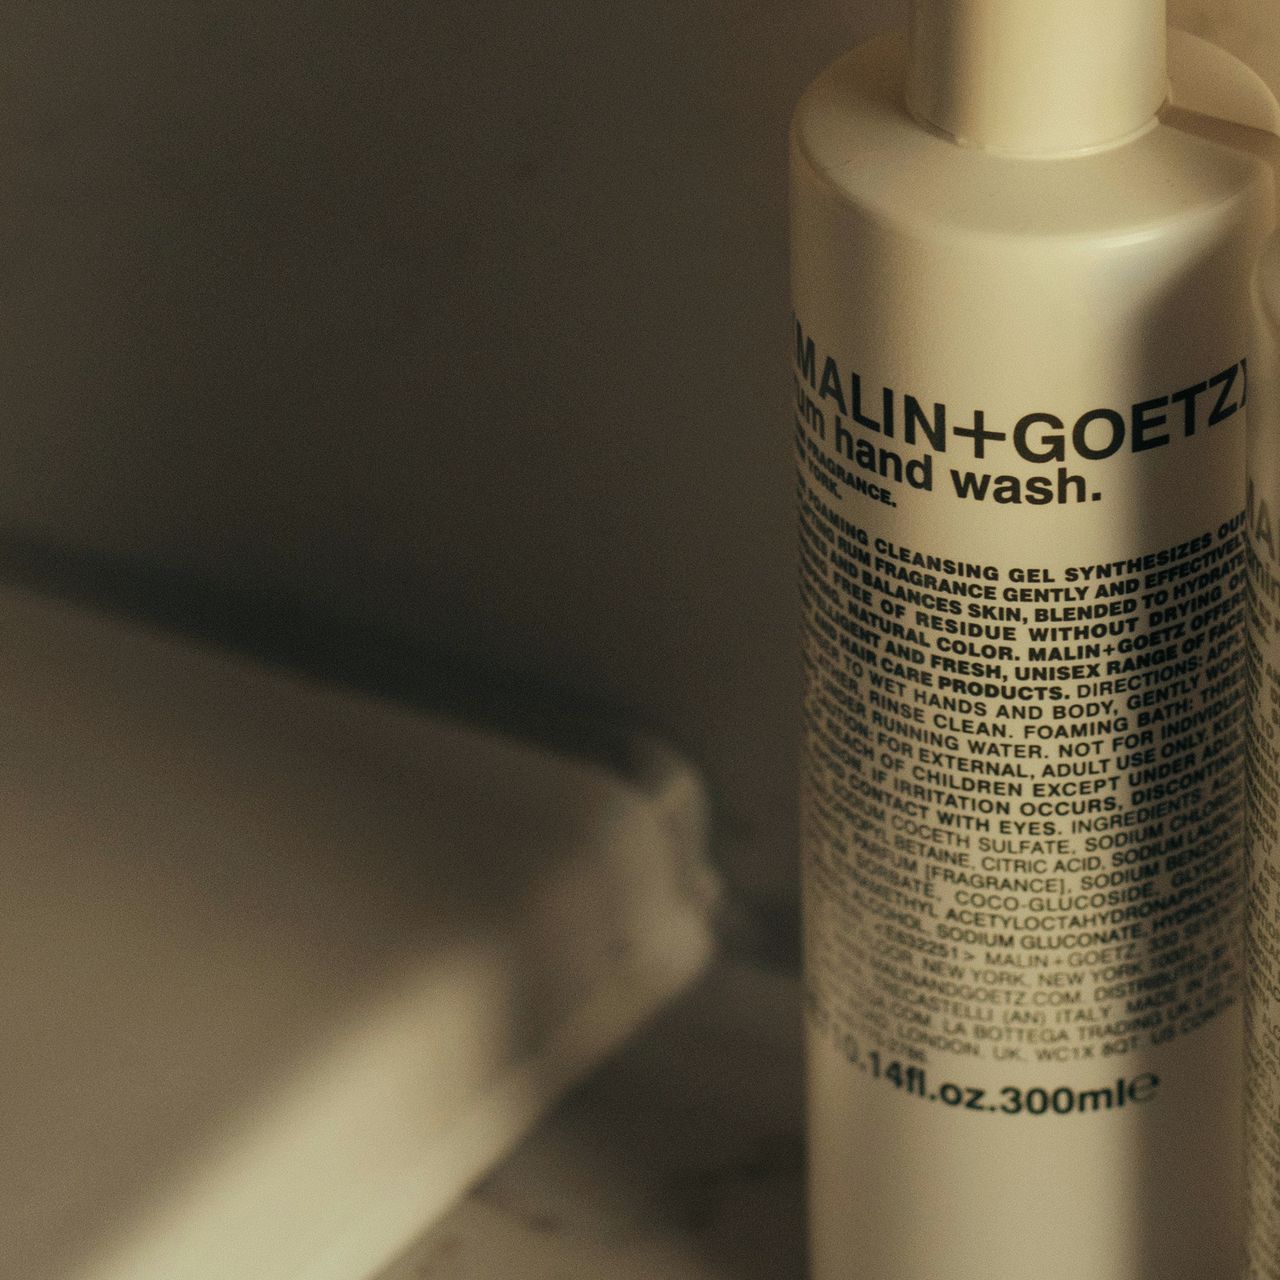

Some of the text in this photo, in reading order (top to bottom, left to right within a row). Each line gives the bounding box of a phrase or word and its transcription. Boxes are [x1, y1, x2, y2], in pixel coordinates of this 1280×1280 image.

[835, 416, 933, 492] hand
[950, 467, 1102, 506] wash.
[874, 537, 1000, 581] CLEANSING
[1008, 568, 1056, 583] GEL
[1064, 530, 1212, 582] SYNTHESIZES
[874, 557, 1140, 603] FRAGRANCE GENTLY AND
[834, 570, 1222, 642] FREE OF RESIDUE WITHOUT DRYING
[862, 569, 1168, 626] BALANCES SKIN, BLENDED TO
[848, 599, 1186, 661] NATURAL COLOR. MALIN+GOETZ
[882, 652, 1204, 700] CARE PRODUCTS. DIRECTIONS:
[886, 632, 1204, 684] AND FRESH, UNISEX RANGE OF
[868, 670, 1200, 720] WET HANDS AND BODY, GENTLY
[870, 689, 1194, 739] RINSE CLEAN. FOAMING BATH:
[872, 710, 1154, 759] RUNNING WATER. NOT FOR
[876, 731, 1156, 782] FOR EXTERNAL, ADULT USE
[880, 752, 1196, 798] OF CHILDREN EXCEPT UNDER
[892, 777, 1010, 816] IRRITATION
[890, 814, 1164, 852] COCETH SODIUM
[936, 810, 1062, 836] WITH EYES.
[980, 856, 1048, 874] CITRIC
[936, 924, 1014, 949] SODIUM
